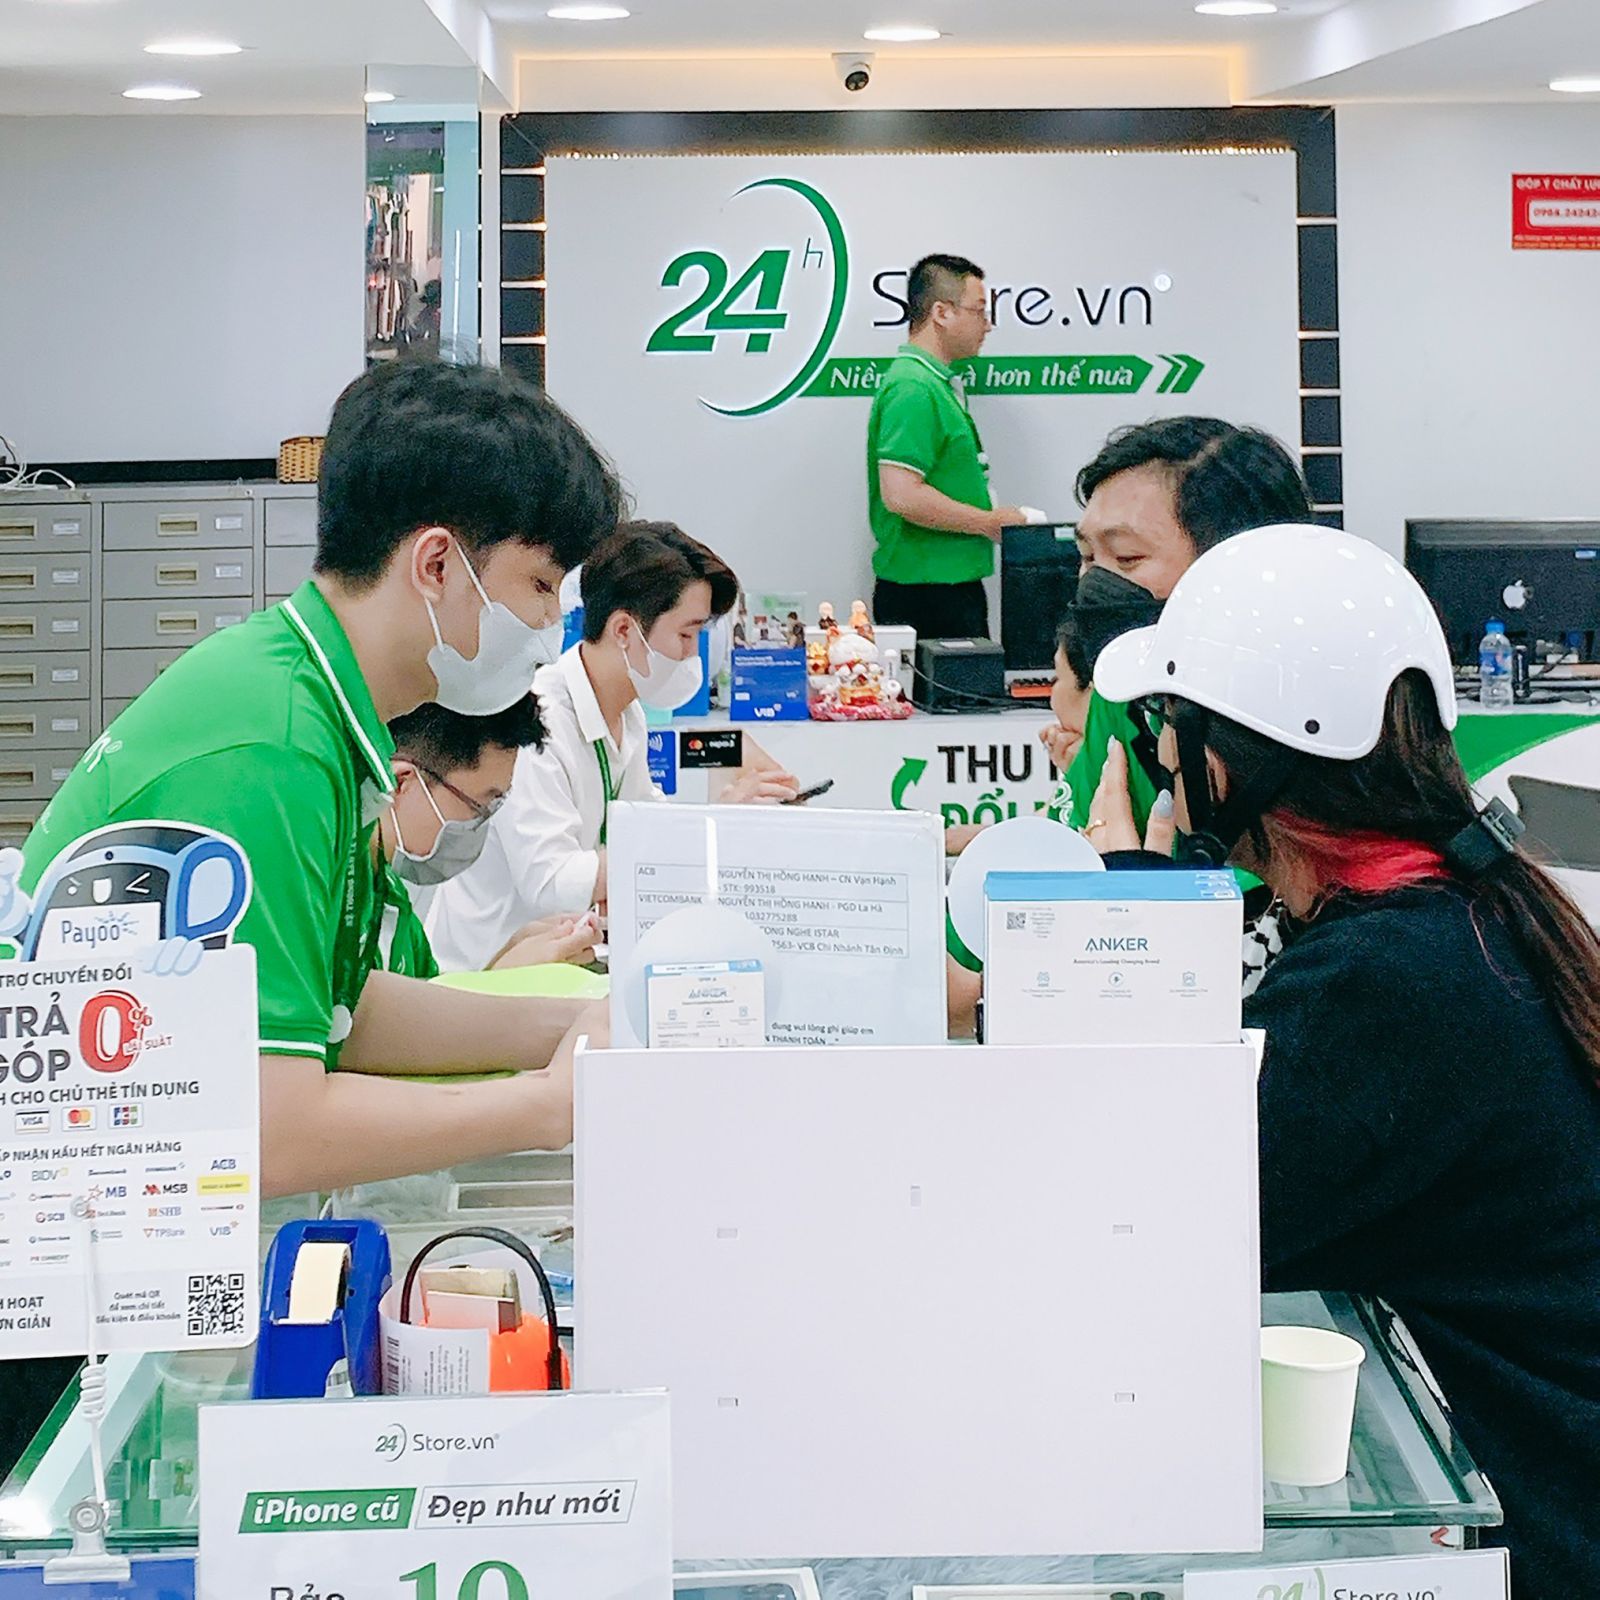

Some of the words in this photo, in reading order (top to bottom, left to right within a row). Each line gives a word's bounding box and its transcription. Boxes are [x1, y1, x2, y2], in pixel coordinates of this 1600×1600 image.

[829, 361, 885, 390] Niề
[984, 364, 1031, 388] hơn
[937, 744, 1032, 783] THU
[638, 867, 656, 876] ACB
[638, 894, 703, 904] VIETCOMBANK
[61, 920, 121, 948] Payoo
[1085, 937, 1149, 952] ANKER
[0, 991, 70, 1038] TRẢ
[10, 1090, 45, 1105] CHO
[152, 1081, 200, 1100] DỤNG
[210, 1159, 237, 1171] ACB
[105, 1186, 128, 1198] MB
[163, 1184, 189, 1194] MSB
[375, 1435, 398, 1452] 24
[412, 1433, 495, 1452] Store.vn
[254, 1498, 356, 1524] iPhone
[365, 1493, 400, 1522] cũ
[428, 1496, 486, 1525] Đẹp
[496, 1495, 554, 1517] như
[562, 1489, 620, 1514] mới
